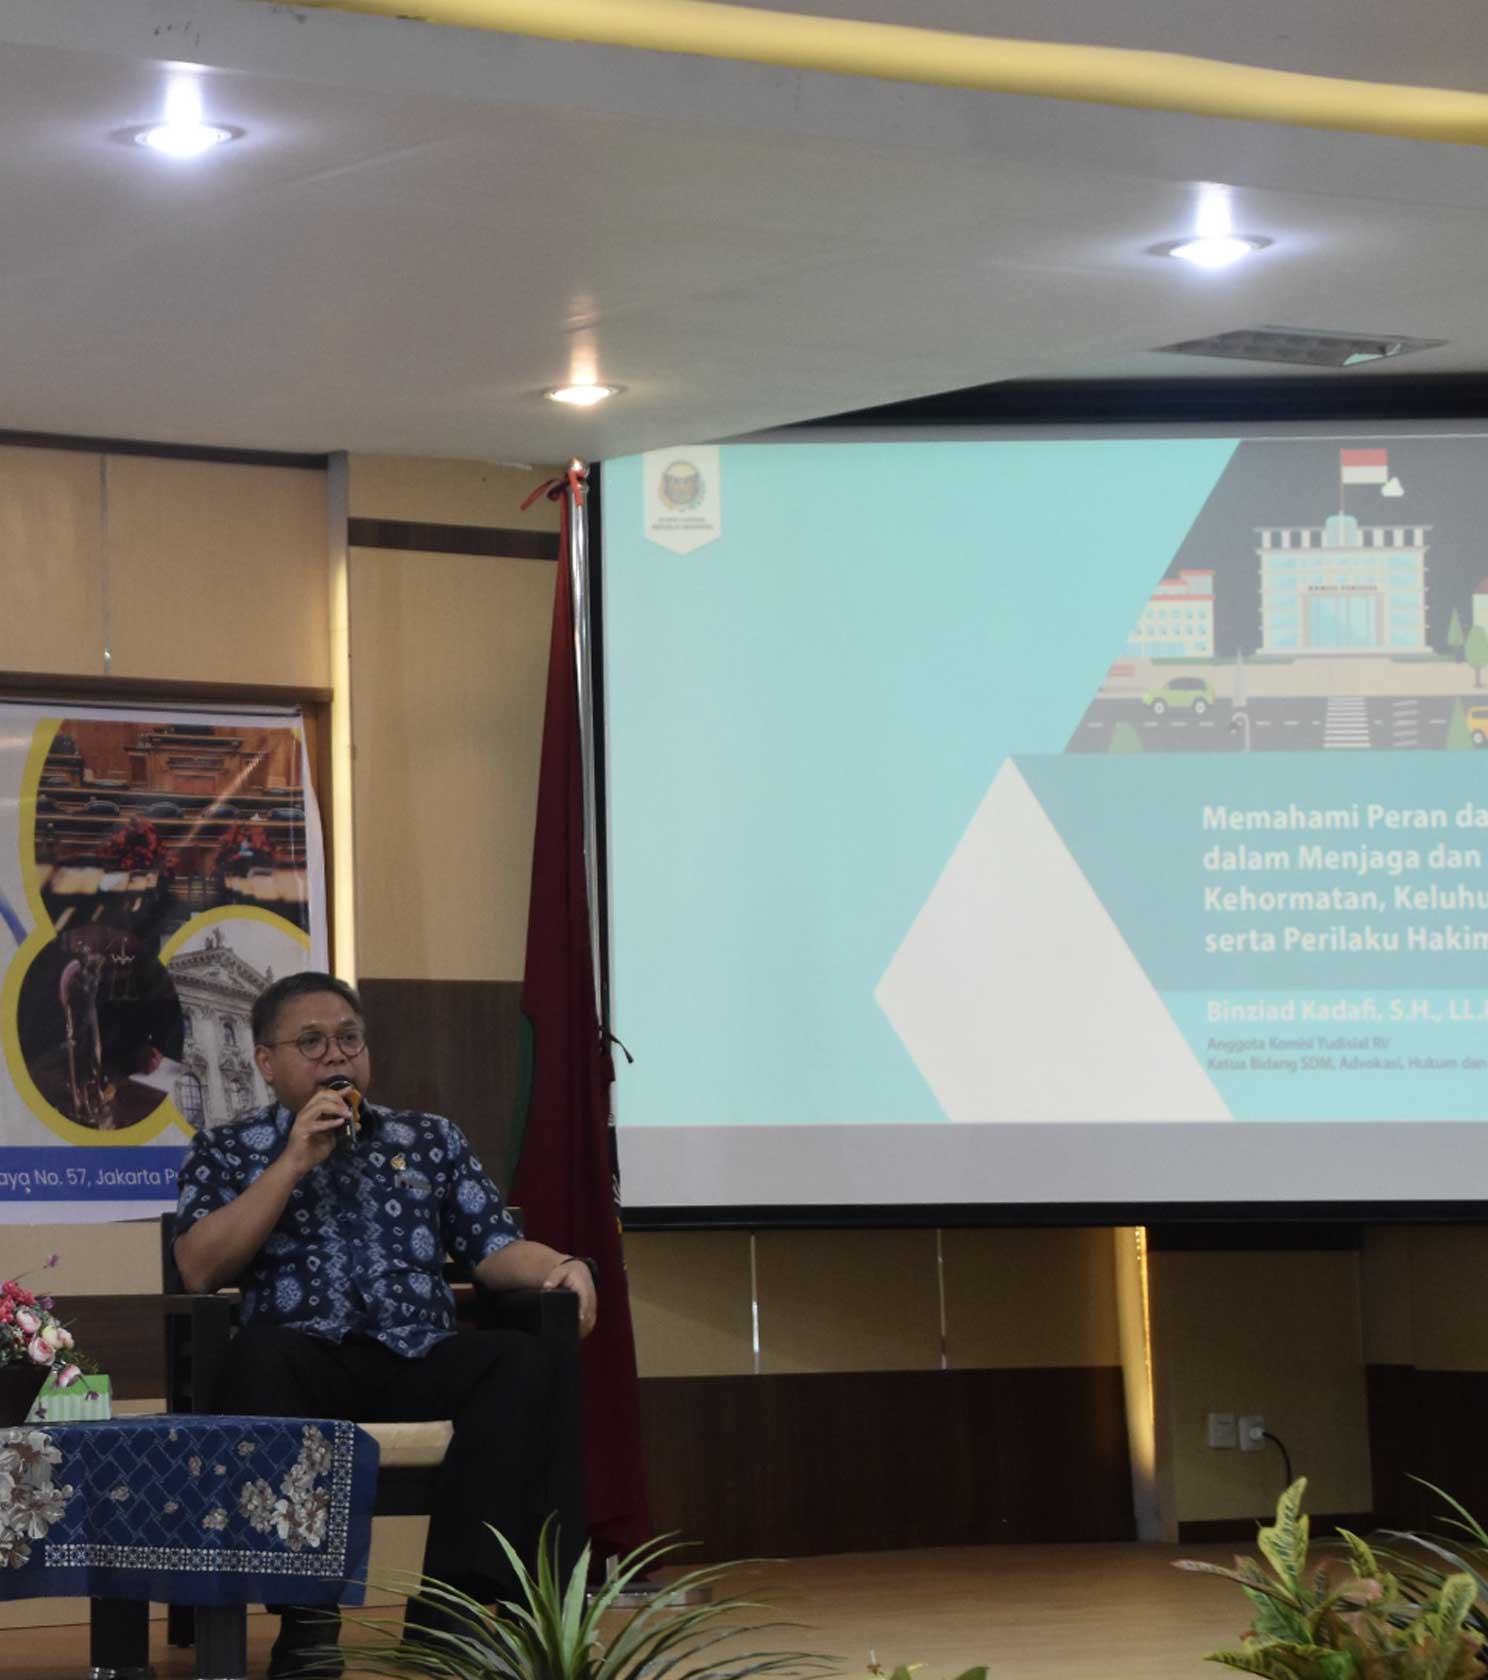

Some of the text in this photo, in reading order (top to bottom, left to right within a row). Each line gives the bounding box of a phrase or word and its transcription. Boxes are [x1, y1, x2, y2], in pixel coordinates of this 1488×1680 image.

[1202, 803, 1360, 829] Memahami
[1368, 803, 1448, 829] Peran
[1203, 843, 1482, 875] dalam Menjaga dan
[1205, 885, 1386, 912] Kehormatan,
[1205, 929, 1276, 952] serta
[1284, 926, 1399, 952] Perilaku
[34, 1170, 64, 1186] No.
[67, 1169, 92, 1189] 57,
[96, 1167, 161, 1186] Jakarta
